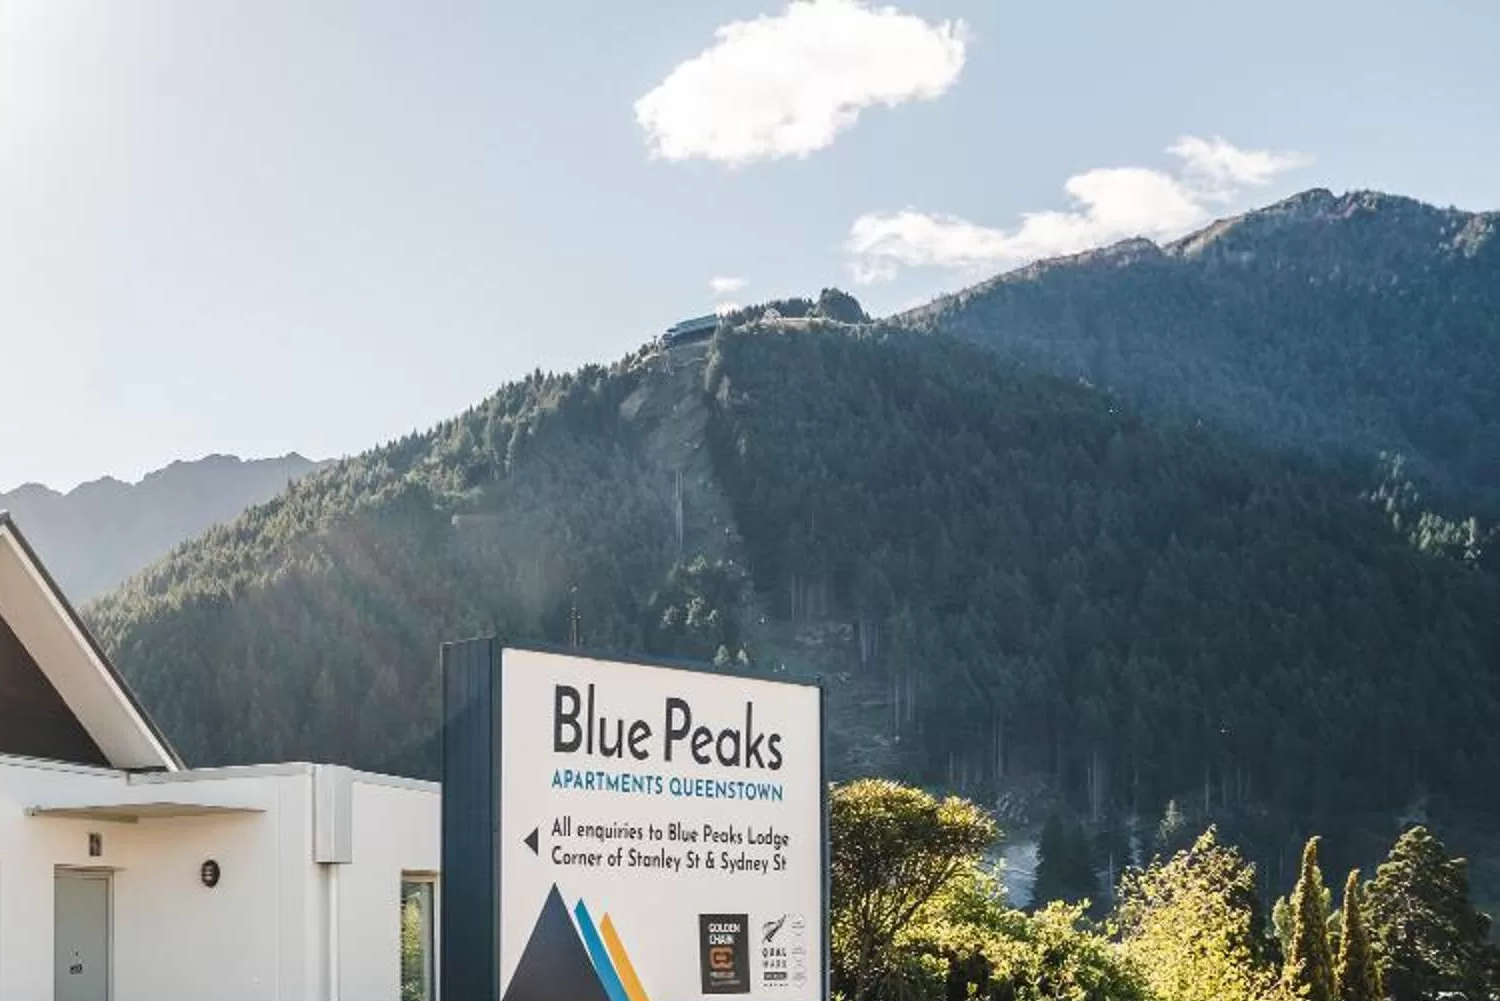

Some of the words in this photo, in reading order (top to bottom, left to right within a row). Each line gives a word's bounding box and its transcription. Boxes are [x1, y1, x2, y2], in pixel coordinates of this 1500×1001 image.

[553, 683, 652, 761] Blue
[664, 697, 783, 771] Peaks
[551, 769, 663, 795] APARTMENTS
[669, 776, 784, 802] QUEENSTOWN
[551, 815, 571, 837] All
[577, 821, 643, 842] enquiries
[649, 823, 663, 841] to
[668, 821, 699, 843] Blue
[703, 823, 743, 845] Peaks
[748, 825, 789, 850] Lodge
[551, 845, 601, 867] Corner
[607, 847, 623, 867] of
[627, 848, 681, 872] Stanley
[686, 851, 701, 869] St
[705, 852, 715, 869] &
[720, 851, 769, 875] Sydney
[773, 853, 787, 871] St
[708, 923, 741, 933] GOLDEN
